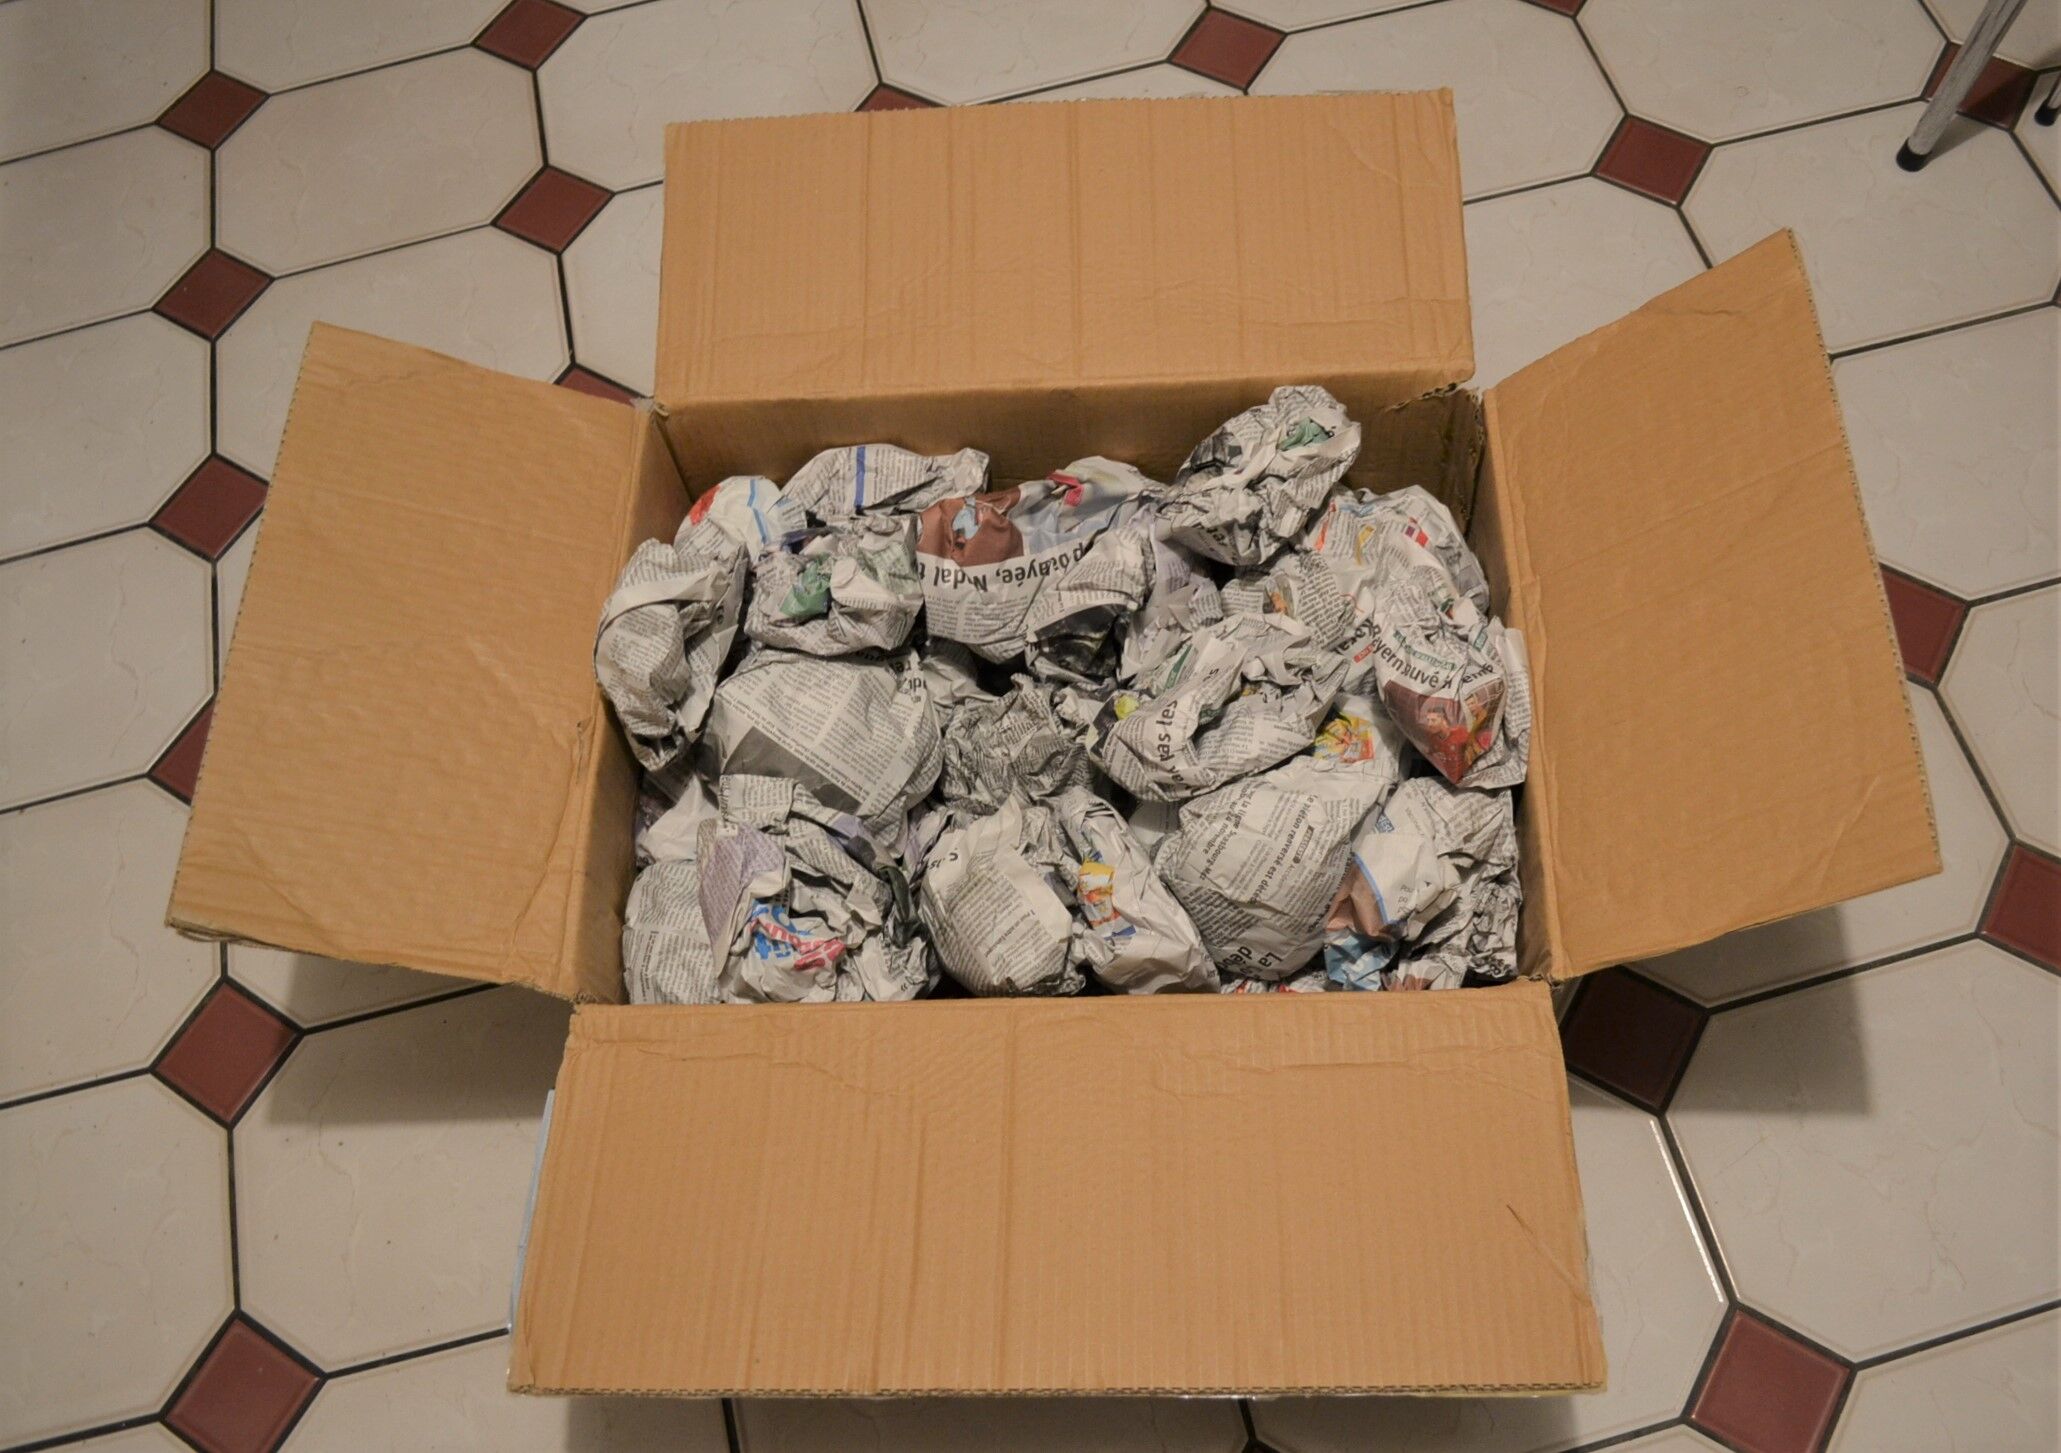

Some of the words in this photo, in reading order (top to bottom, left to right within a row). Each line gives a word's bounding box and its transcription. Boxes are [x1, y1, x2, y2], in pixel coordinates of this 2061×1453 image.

[1155, 699, 1179, 727] les
[1275, 829, 1297, 867] renversé
[1264, 866, 1278, 880] est
[1258, 951, 1282, 968] La
